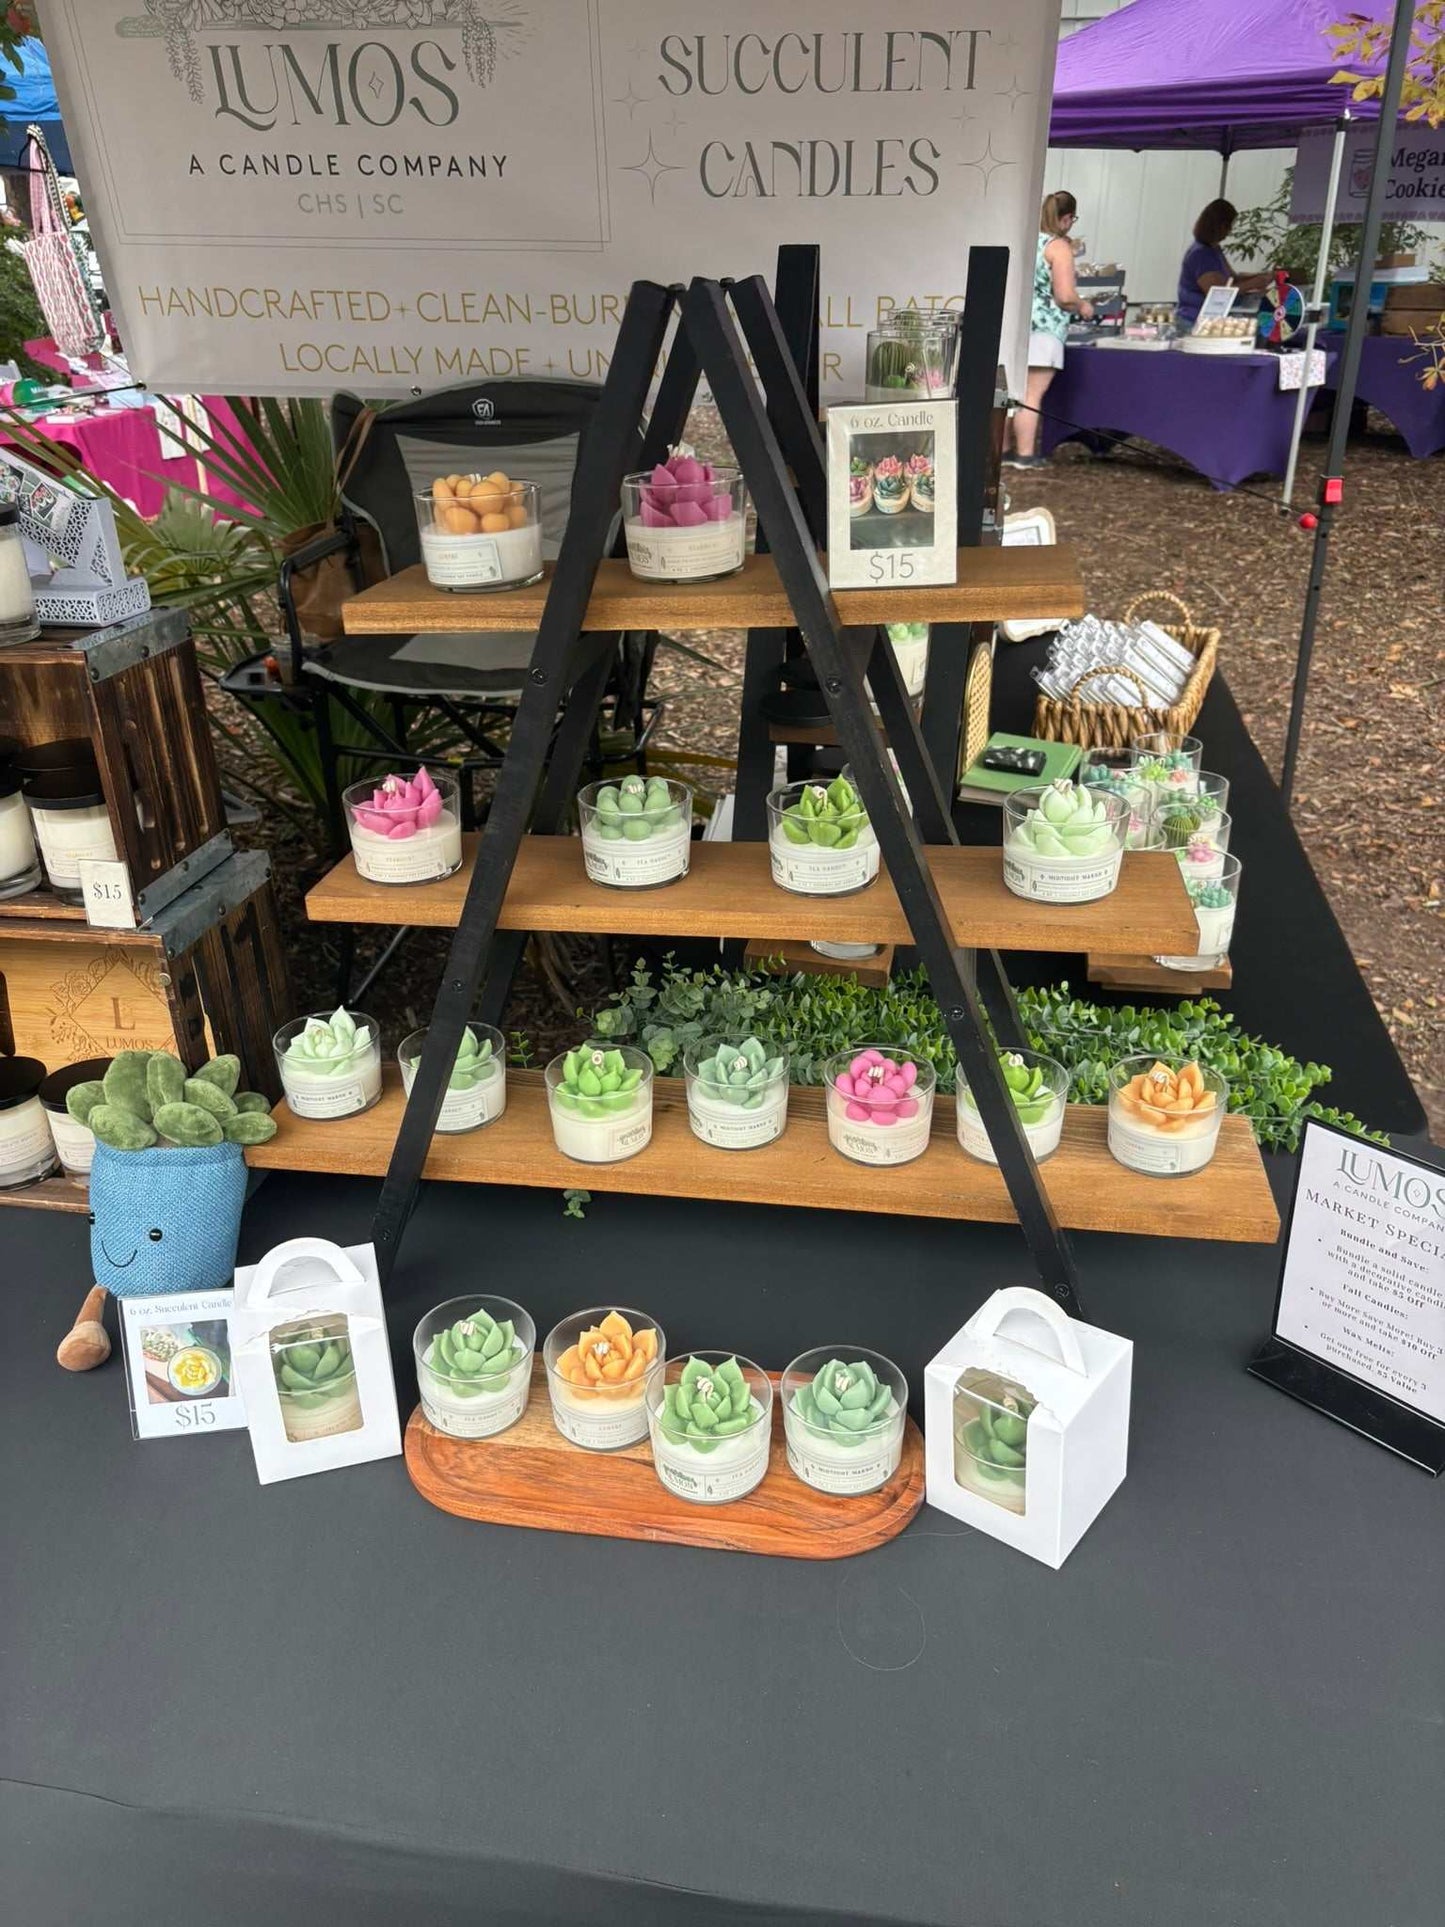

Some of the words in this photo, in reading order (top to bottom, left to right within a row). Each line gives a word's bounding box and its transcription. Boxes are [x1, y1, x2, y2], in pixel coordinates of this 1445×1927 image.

[657, 29, 992, 96] SUCCULENT
[207, 41, 460, 132] LUMOS
[188, 154, 204, 176] A
[218, 154, 340, 177] CANDLE
[357, 154, 510, 179] COMPANY
[699, 137, 942, 199] CANDLES
[297, 194, 349, 215] CHS
[373, 194, 405, 215] SC
[138, 286, 396, 323] HANDCRAFTED
[415, 291, 628, 326] CLEAN-BUR
[279, 343, 423, 374] LOCALLY
[435, 347, 530, 377] MADE
[850, 415, 859, 428] 6
[864, 417, 884, 428] oz.
[887, 410, 934, 428] Candle
[869, 551, 915, 584] $15
[93, 881, 122, 900] $15
[111, 997, 136, 1031] L
[106, 1036, 153, 1050] LUMOS
[1306, 1188, 1380, 1230] MARKET
[1333, 1181, 1341, 1189] A
[1344, 1184, 1391, 1209] CANDLE
[1340, 1228, 1376, 1249] Bundle
[1379, 1247, 1398, 1260] and
[1328, 1250, 1349, 1265] with
[1360, 1265, 1413, 1295] decorative
[1336, 1245, 1370, 1265] Bundle
[1381, 1266, 1406, 1282] solid
[1409, 1279, 1443, 1298] candle
[1348, 1269, 1366, 1281] and
[1369, 1278, 1390, 1293] take
[1343, 1283, 1361, 1298] Fall
[175, 1403, 217, 1428] $15
